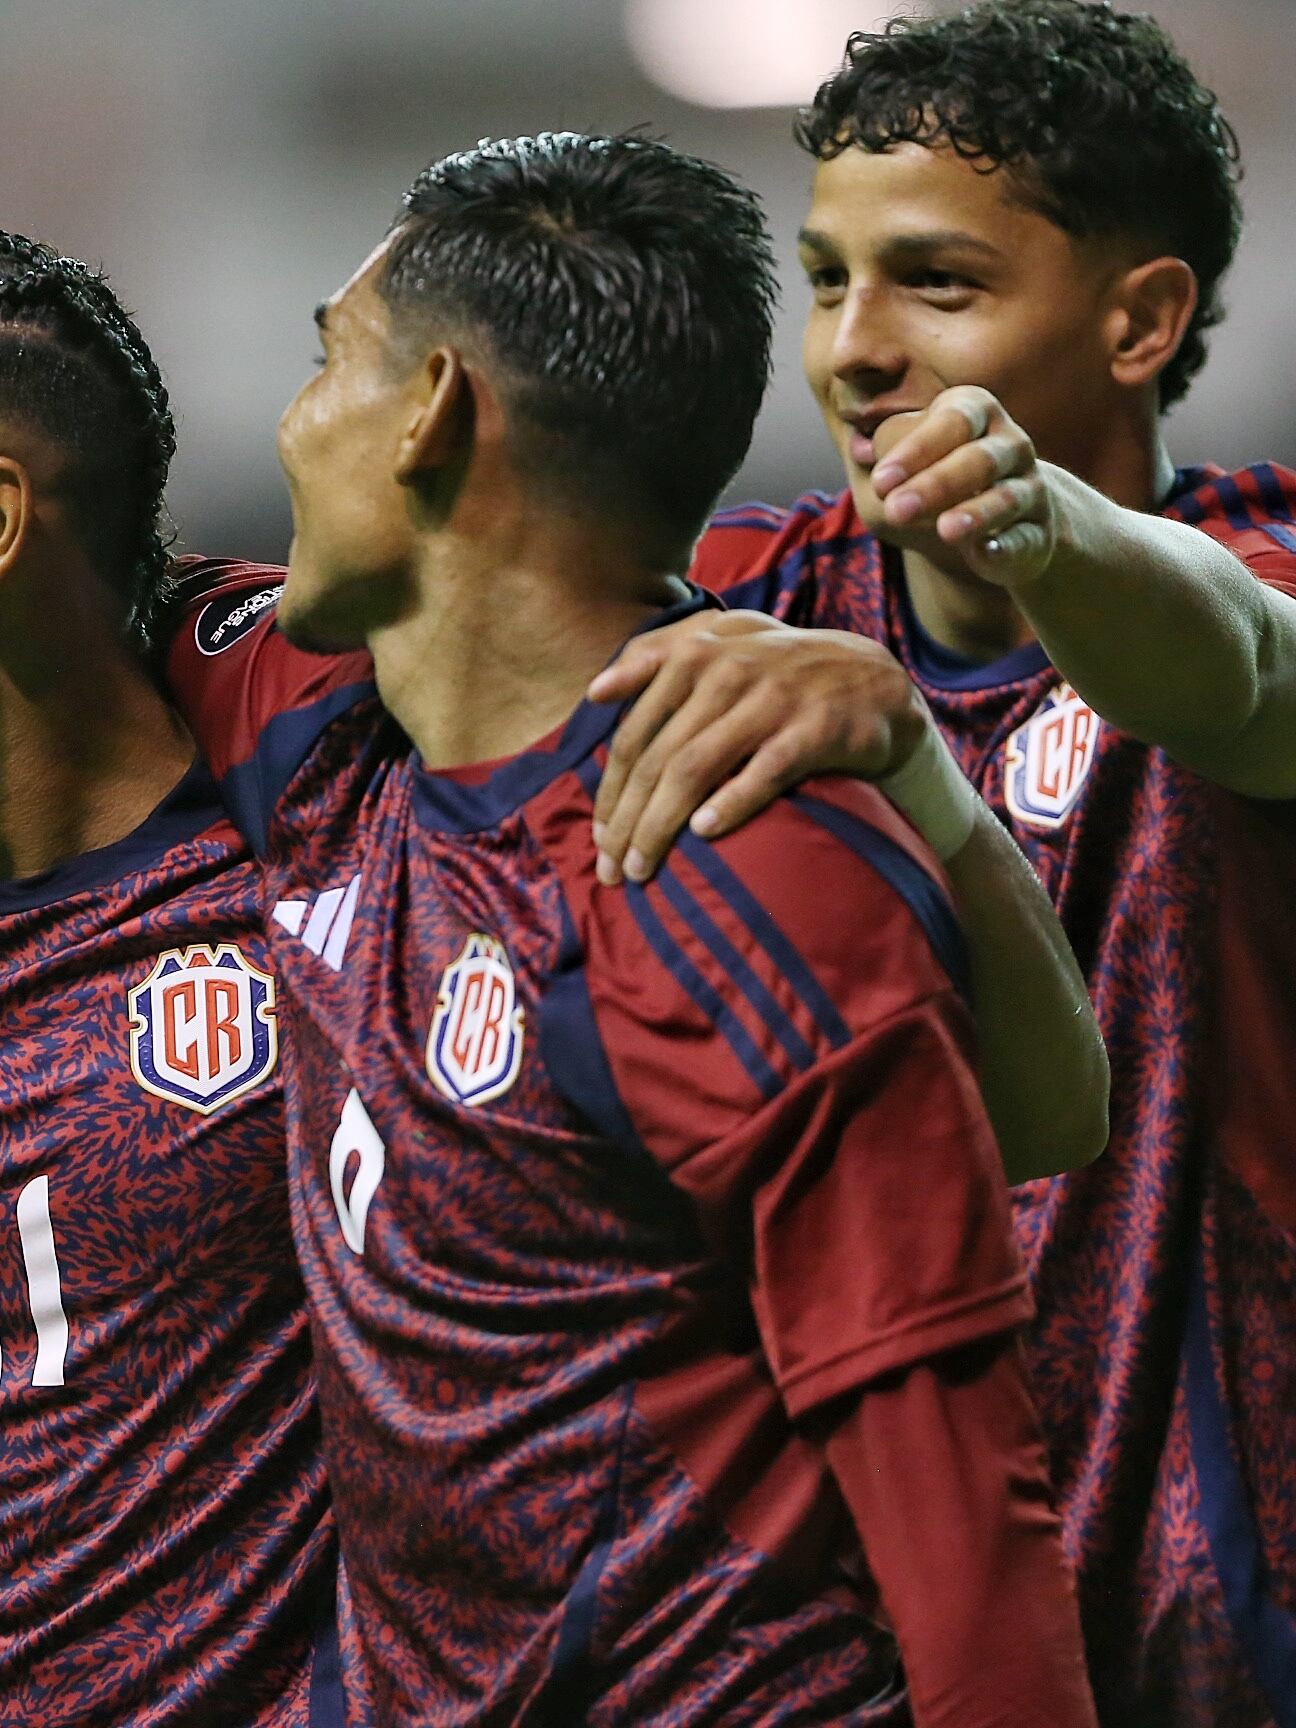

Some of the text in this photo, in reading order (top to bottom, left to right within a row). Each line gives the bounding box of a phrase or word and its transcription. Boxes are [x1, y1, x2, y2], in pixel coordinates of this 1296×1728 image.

[1037, 708, 1091, 798] CR
[163, 979, 241, 1080] CR
[453, 971, 505, 1074] CR
